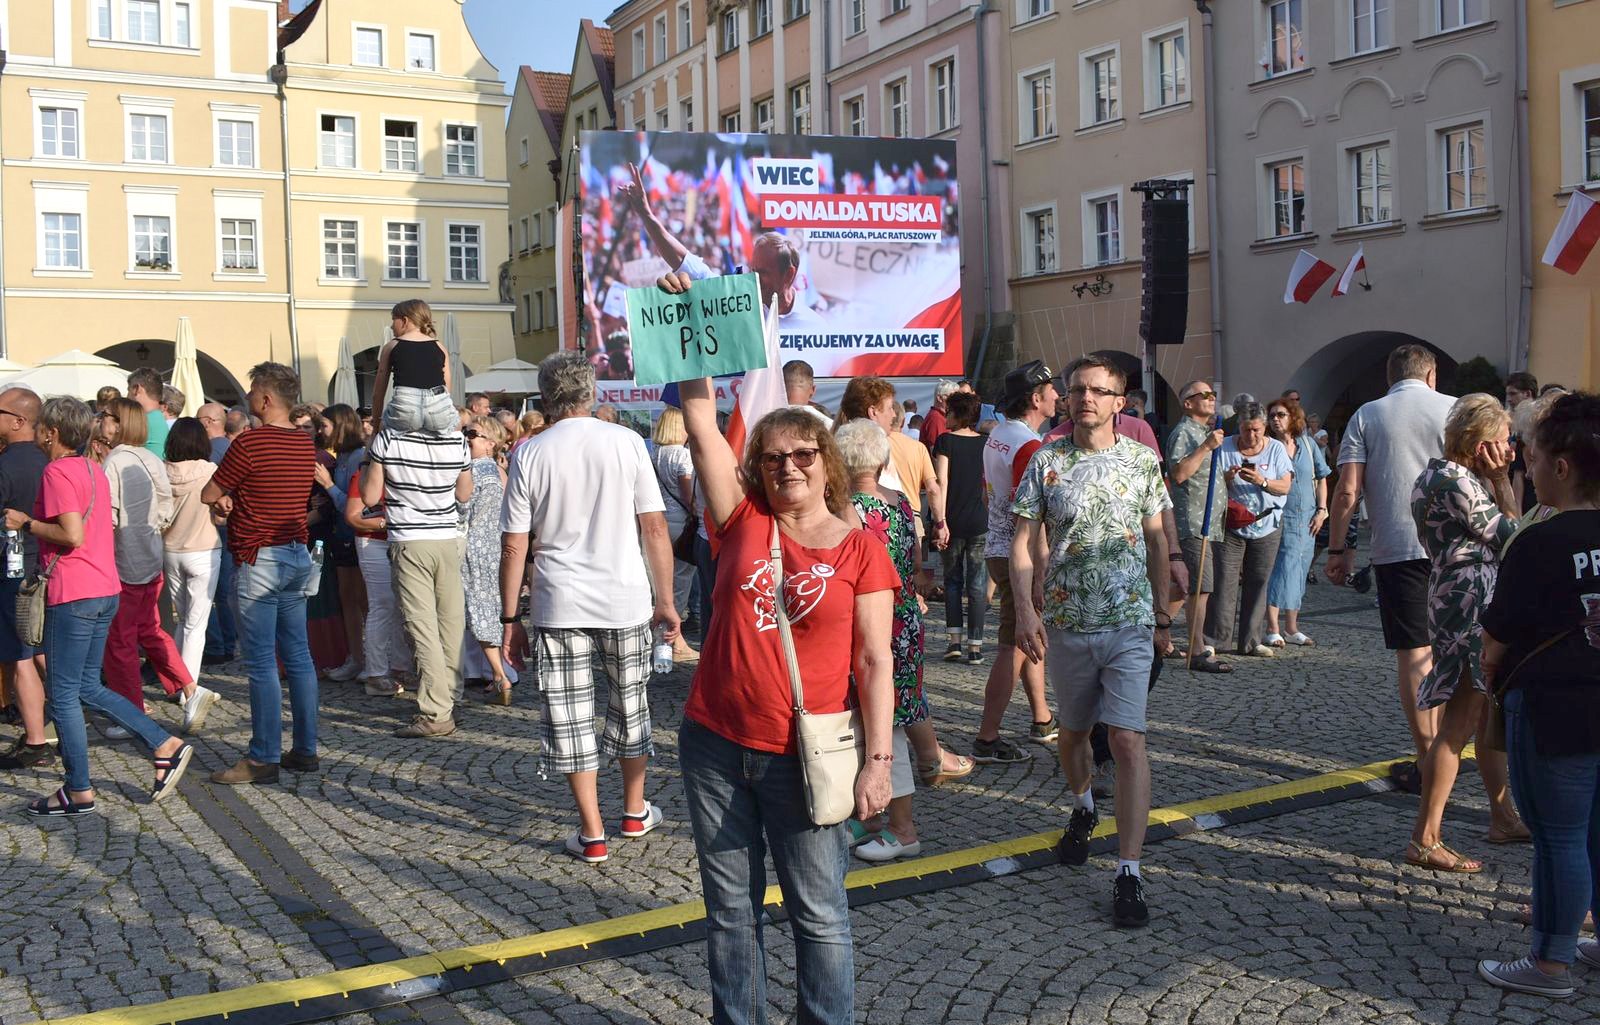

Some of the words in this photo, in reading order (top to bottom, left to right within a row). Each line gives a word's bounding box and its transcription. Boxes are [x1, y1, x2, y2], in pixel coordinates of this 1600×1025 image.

[757, 166, 815, 185] WIEC
[764, 200, 869, 221] DONALDA
[869, 201, 938, 223] TUSKA
[809, 230, 841, 239] JELENIA
[841, 229, 867, 240] GÓRA,
[867, 231, 888, 240] PLAC
[888, 232, 937, 240] RATUSZOWY
[641, 301, 692, 328] NIGDY
[701, 293, 752, 318] WIĘCEJ
[679, 325, 719, 360] PiS
[779, 334, 863, 351] ZIĘKUJEMY
[864, 334, 886, 347] ZA
[886, 334, 940, 350] UWAGĘ
[597, 388, 660, 403] JELENI
[1572, 549, 1600, 580] PR
